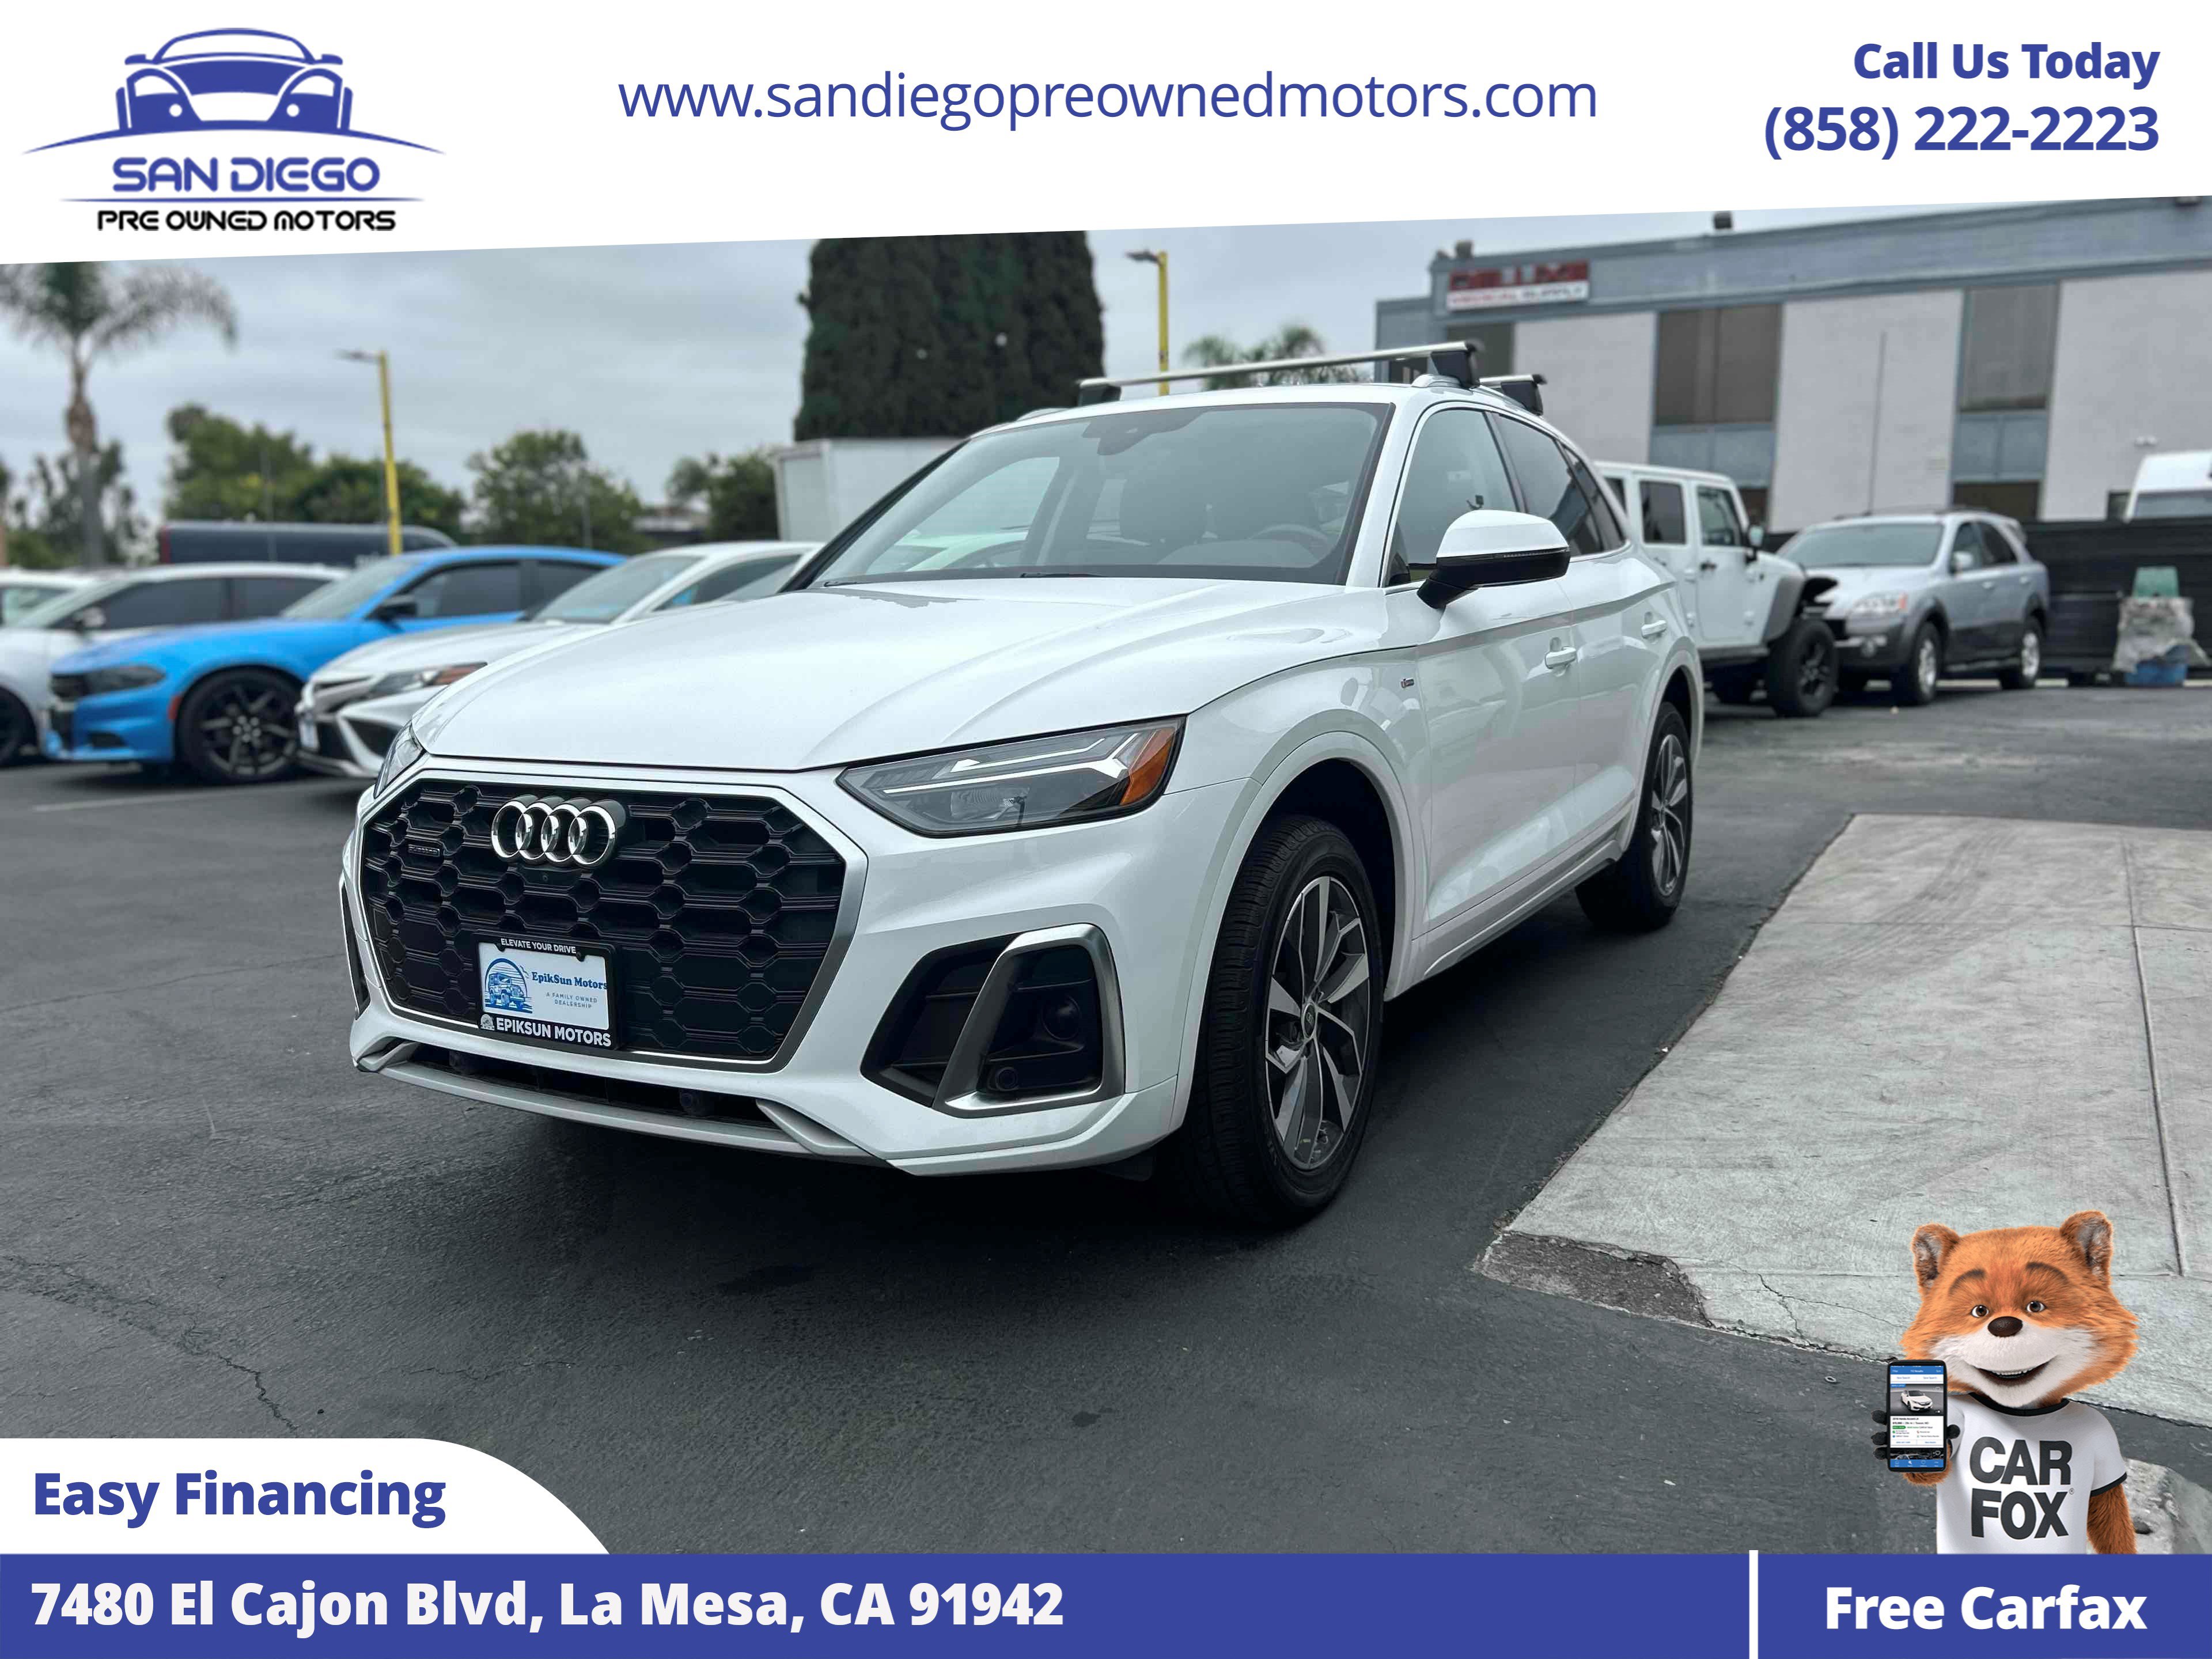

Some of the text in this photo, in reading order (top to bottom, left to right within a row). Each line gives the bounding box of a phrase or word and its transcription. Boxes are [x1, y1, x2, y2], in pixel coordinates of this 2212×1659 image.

[501, 938, 577, 954] ELEVATE YOUR DRIVE
[531, 972, 608, 990] EpikSun Motors
[496, 1017, 612, 1047] EPIKSUN MOTORS
